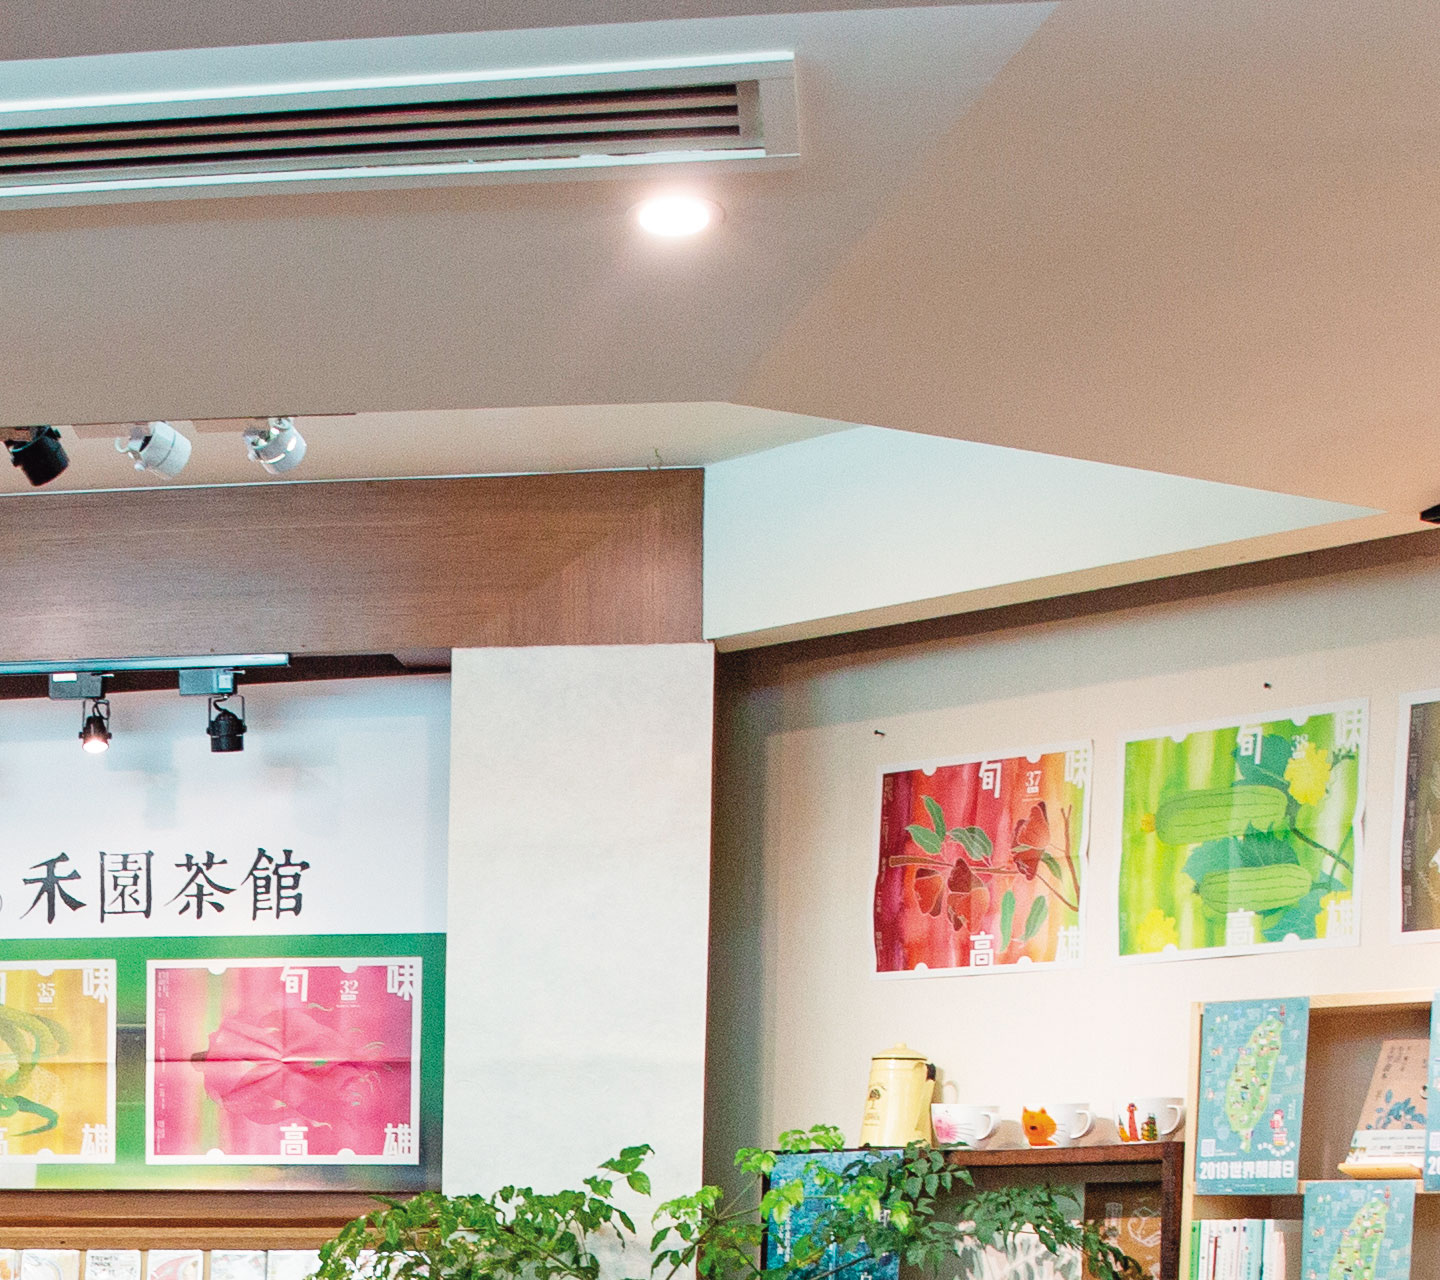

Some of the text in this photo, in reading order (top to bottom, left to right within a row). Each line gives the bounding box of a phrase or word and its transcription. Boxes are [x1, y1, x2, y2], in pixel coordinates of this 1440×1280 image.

[1237, 724, 1263, 765] 旬
[979, 760, 1002, 798] 旬
[1025, 771, 1042, 787] 37
[20, 848, 310, 924] 禾園茶館
[970, 931, 994, 966] 高
[37, 983, 56, 997] 35
[280, 967, 308, 1002] 旬
[340, 980, 359, 993] 32
[279, 1123, 309, 1157] 高
